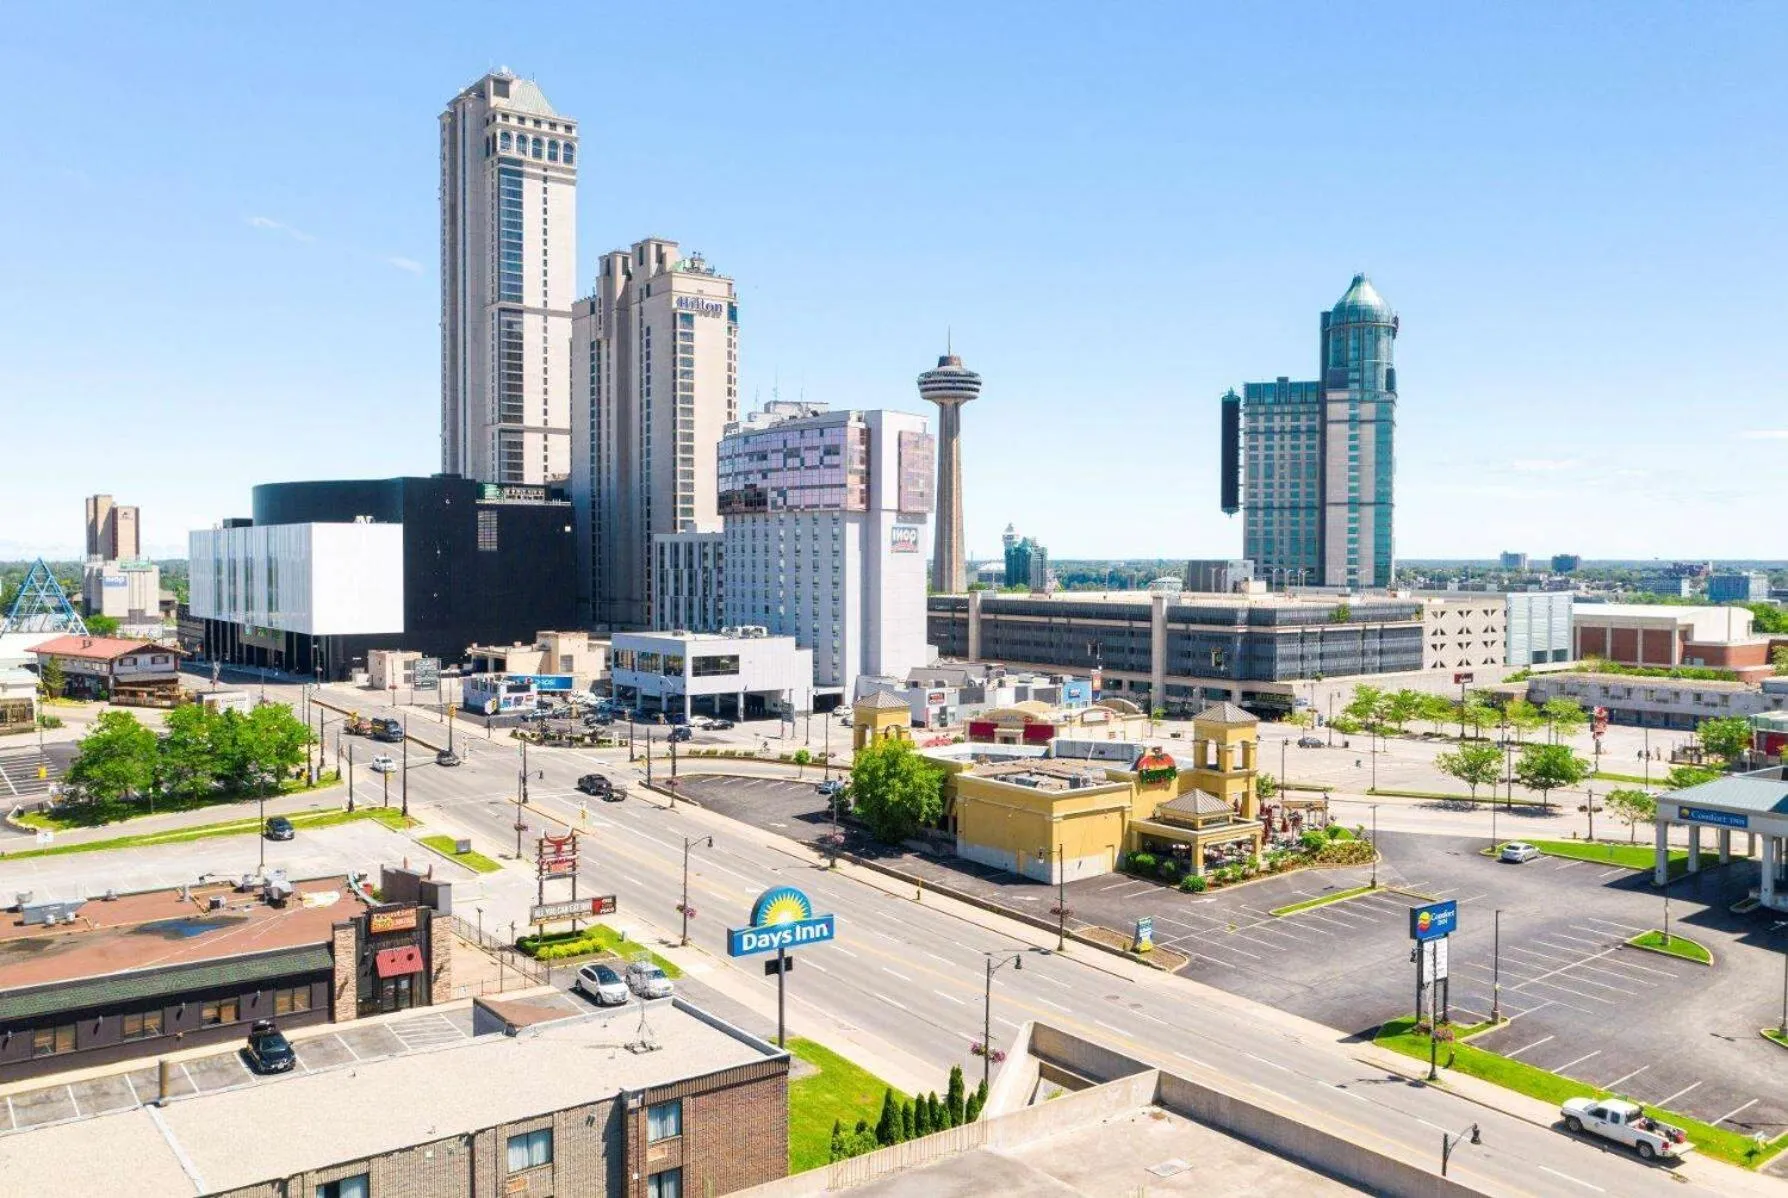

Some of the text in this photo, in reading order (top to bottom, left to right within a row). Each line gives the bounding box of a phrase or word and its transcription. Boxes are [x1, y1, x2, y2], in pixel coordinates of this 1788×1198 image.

[676, 296, 722, 312] Hilton
[1690, 810, 1726, 823] Comfort
[1431, 910, 1454, 921] Comfort
[742, 923, 829, 951] Days Inn
